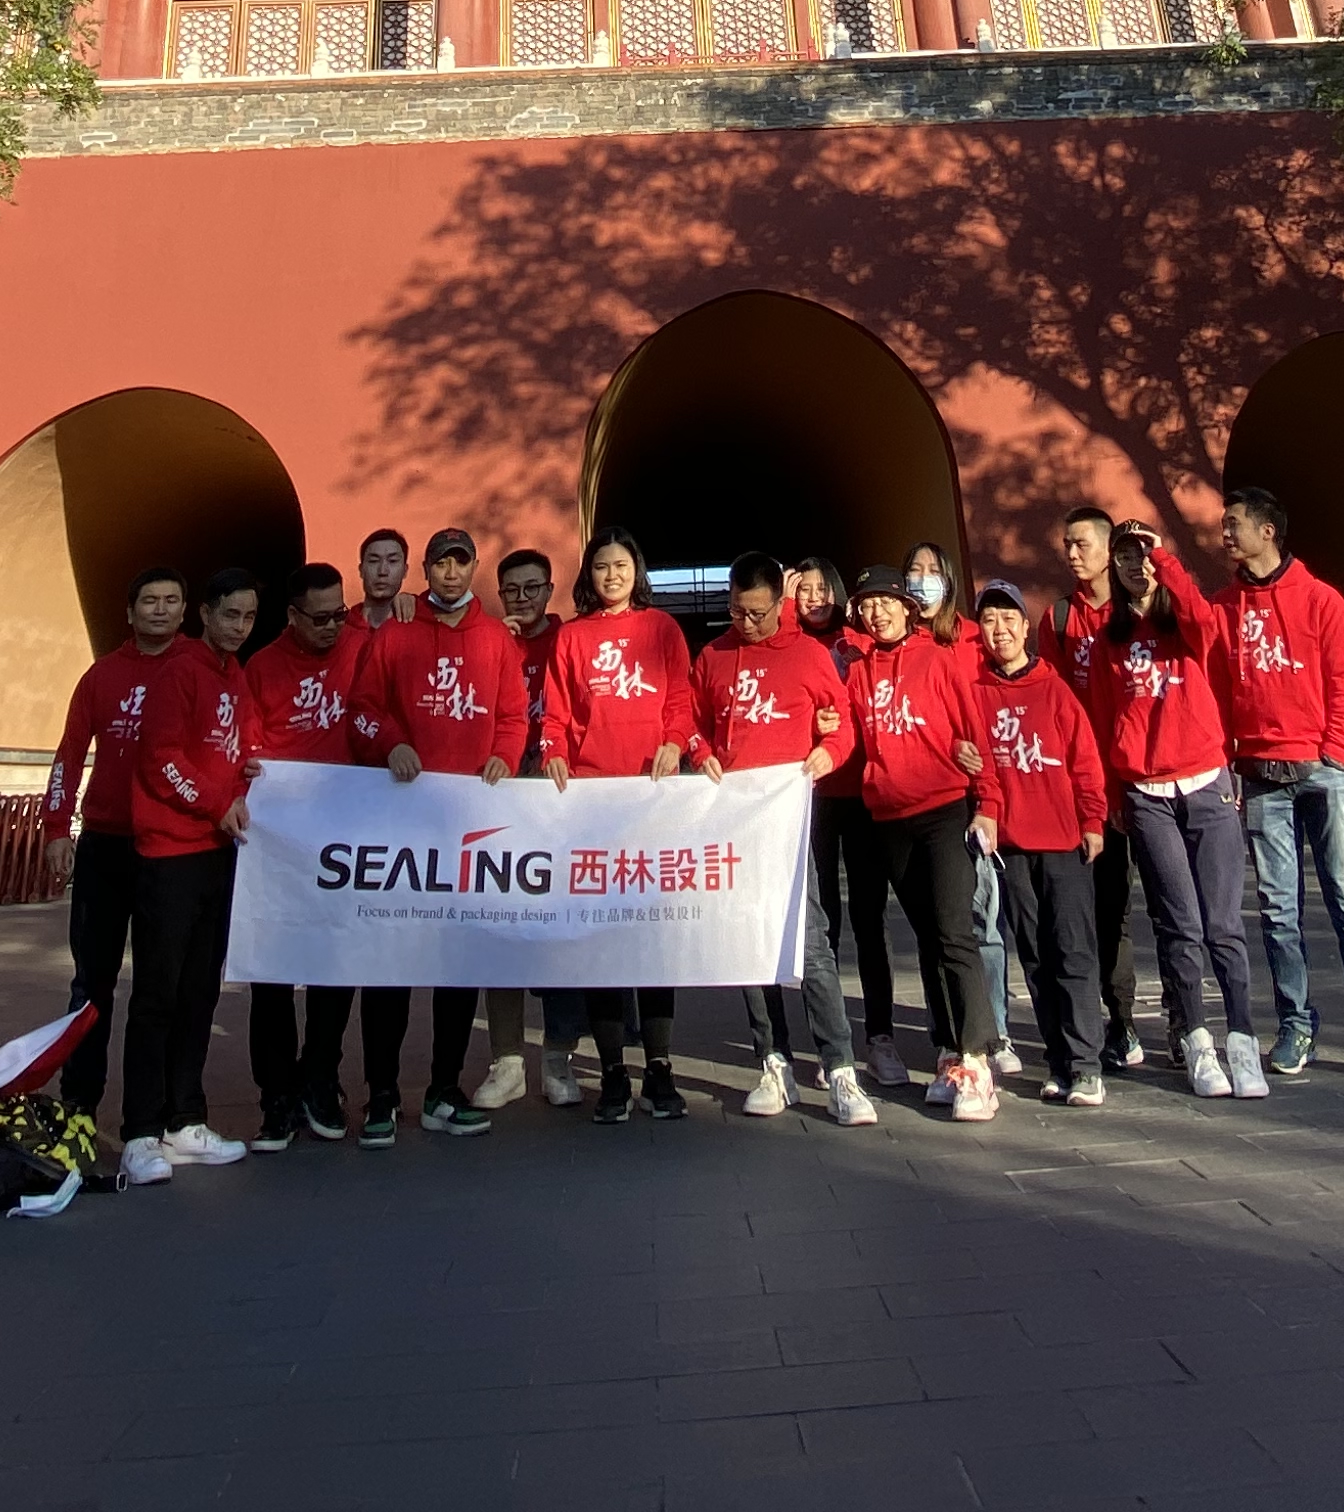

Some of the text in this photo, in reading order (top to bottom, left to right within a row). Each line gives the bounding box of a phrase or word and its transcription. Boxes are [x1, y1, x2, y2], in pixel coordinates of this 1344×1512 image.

[317, 825, 553, 895] SEALING
[569, 842, 742, 895] 西林設計
[357, 905, 391, 918] Focus
[394, 908, 408, 919] on
[411, 906, 444, 919] brand
[460, 908, 518, 923] packaging
[520, 908, 557, 924] design
